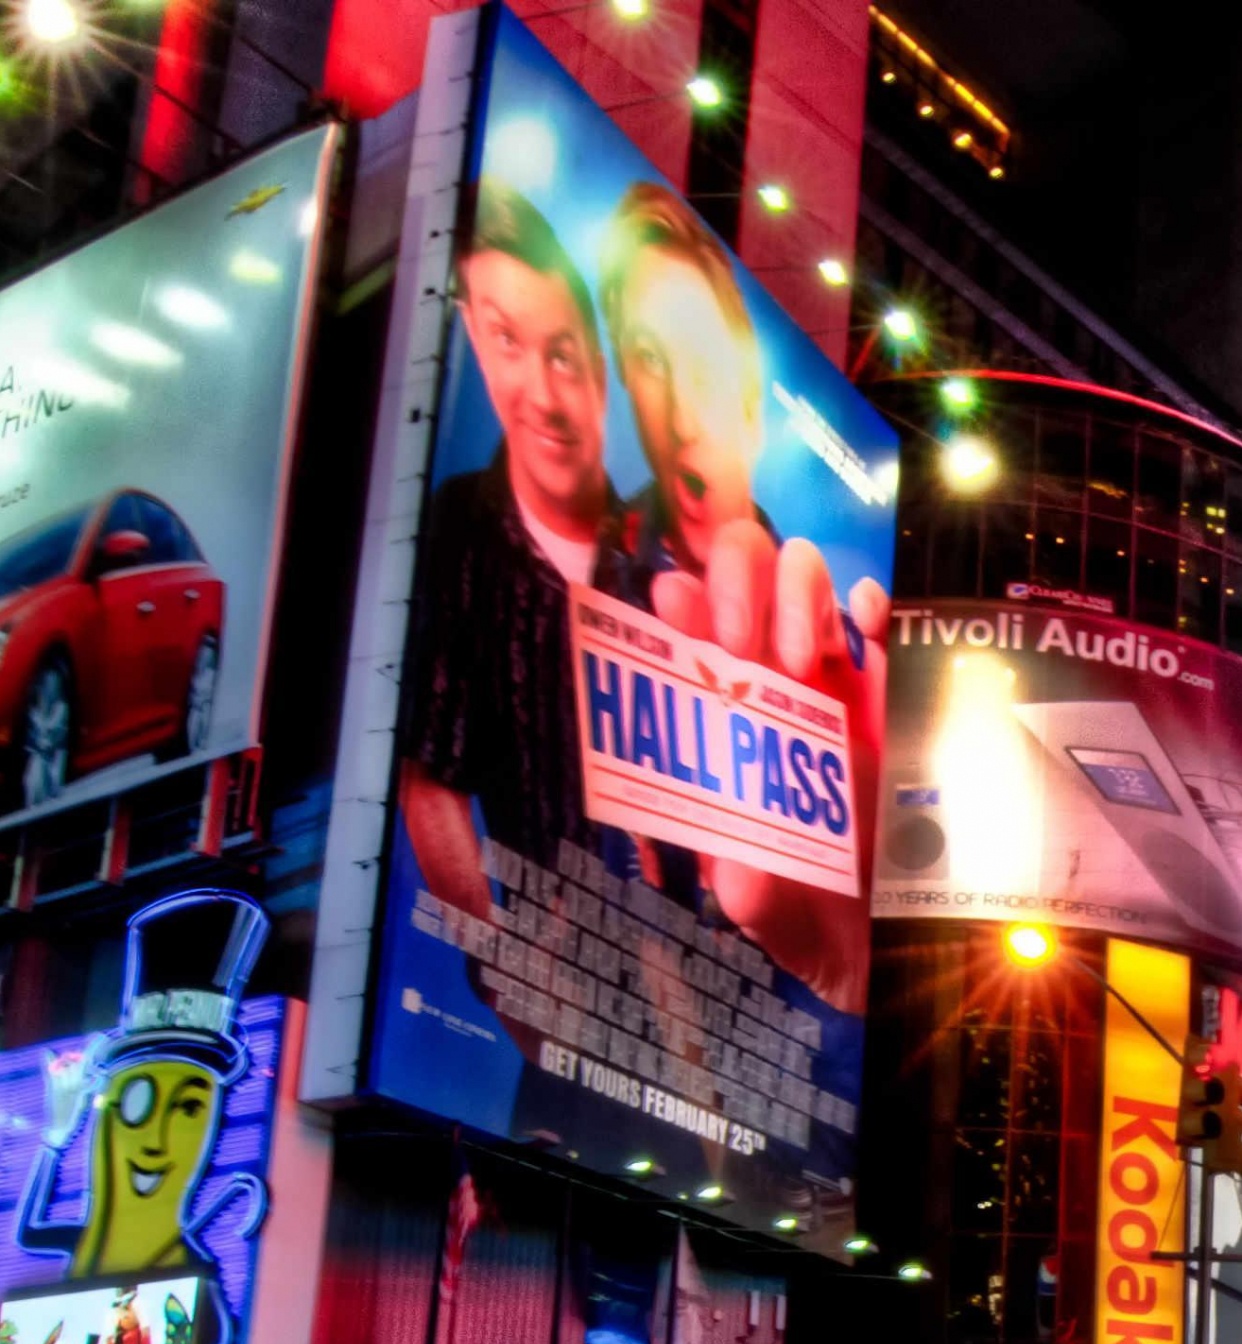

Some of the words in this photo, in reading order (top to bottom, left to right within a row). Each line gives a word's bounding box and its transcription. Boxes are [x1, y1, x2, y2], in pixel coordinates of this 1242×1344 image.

[893, 610, 1023, 650] Tivoli
[582, 648, 722, 793] HALL
[729, 711, 848, 837] PASS
[896, 890, 949, 906] YEARS
[954, 891, 978, 906] OF
[983, 891, 1038, 909] RADIO
[539, 1040, 579, 1081] GET
[580, 1056, 641, 1108] YOURS
[642, 1083, 730, 1144] FEBRUARY
